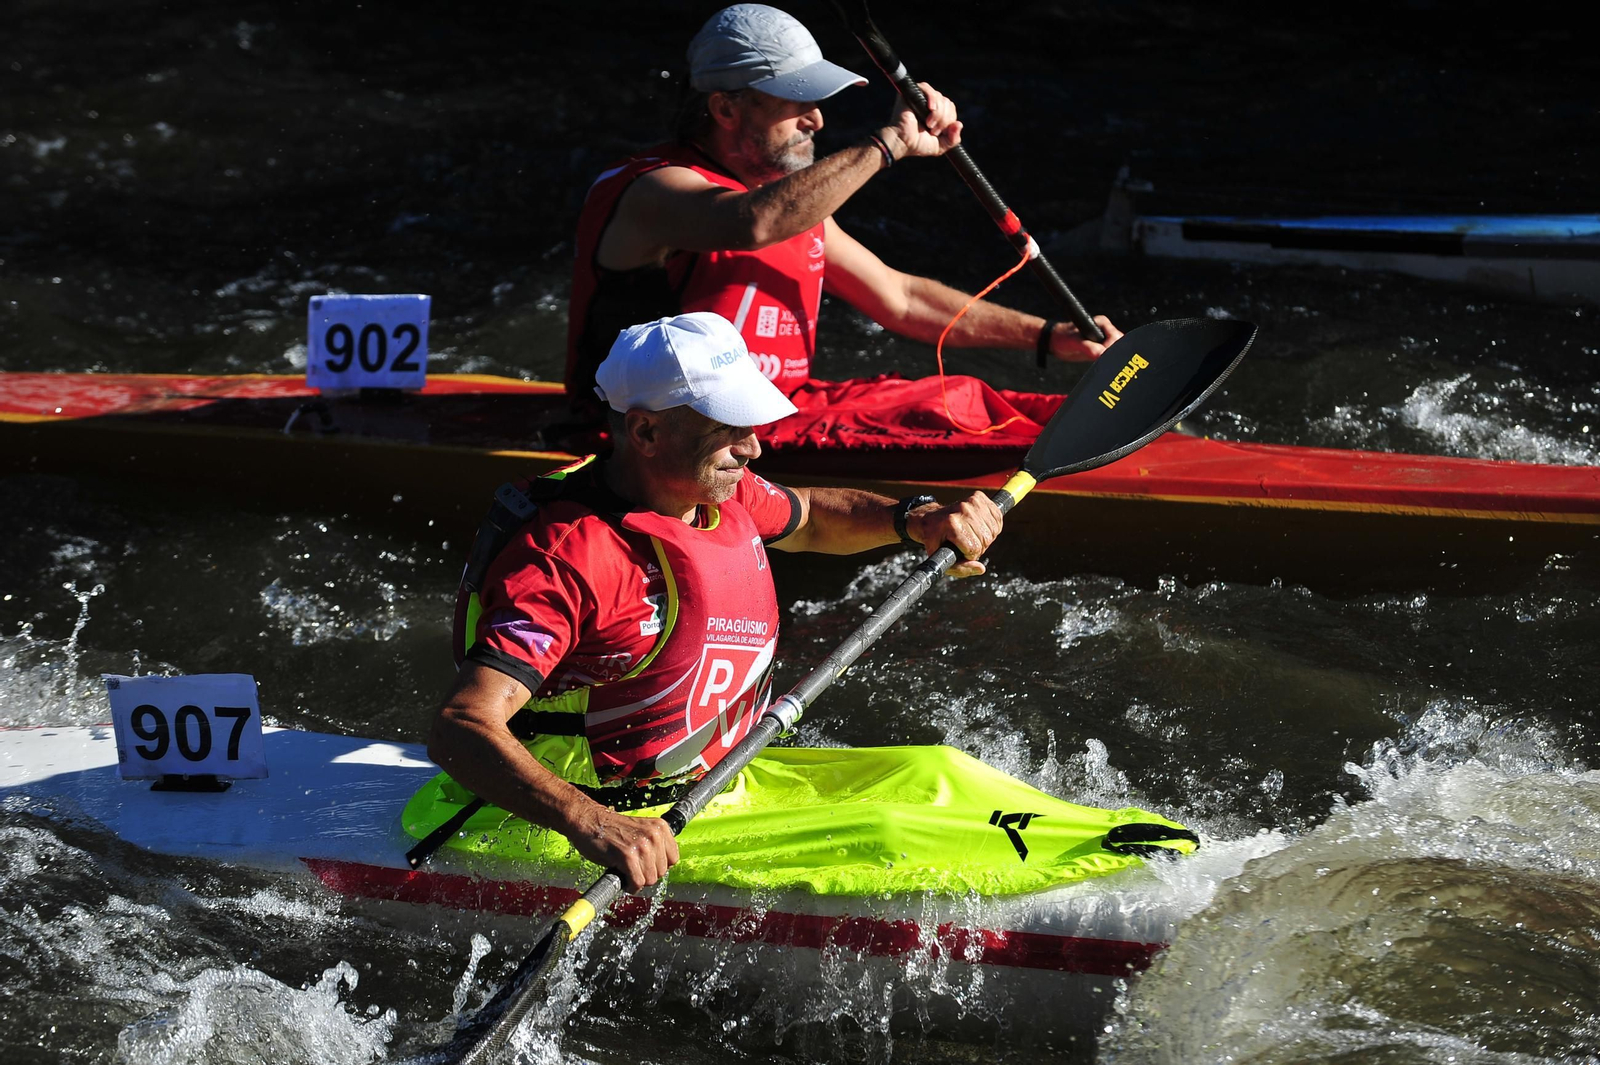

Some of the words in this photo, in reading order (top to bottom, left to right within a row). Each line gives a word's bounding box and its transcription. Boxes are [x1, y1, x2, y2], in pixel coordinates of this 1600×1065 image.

[325, 323, 420, 373] 902
[1098, 390, 1120, 409] VI
[707, 616, 768, 636] PIRAGÜISMO
[741, 636, 748, 644] DE
[748, 637, 766, 645] AROUSA
[130, 704, 251, 762] 907
